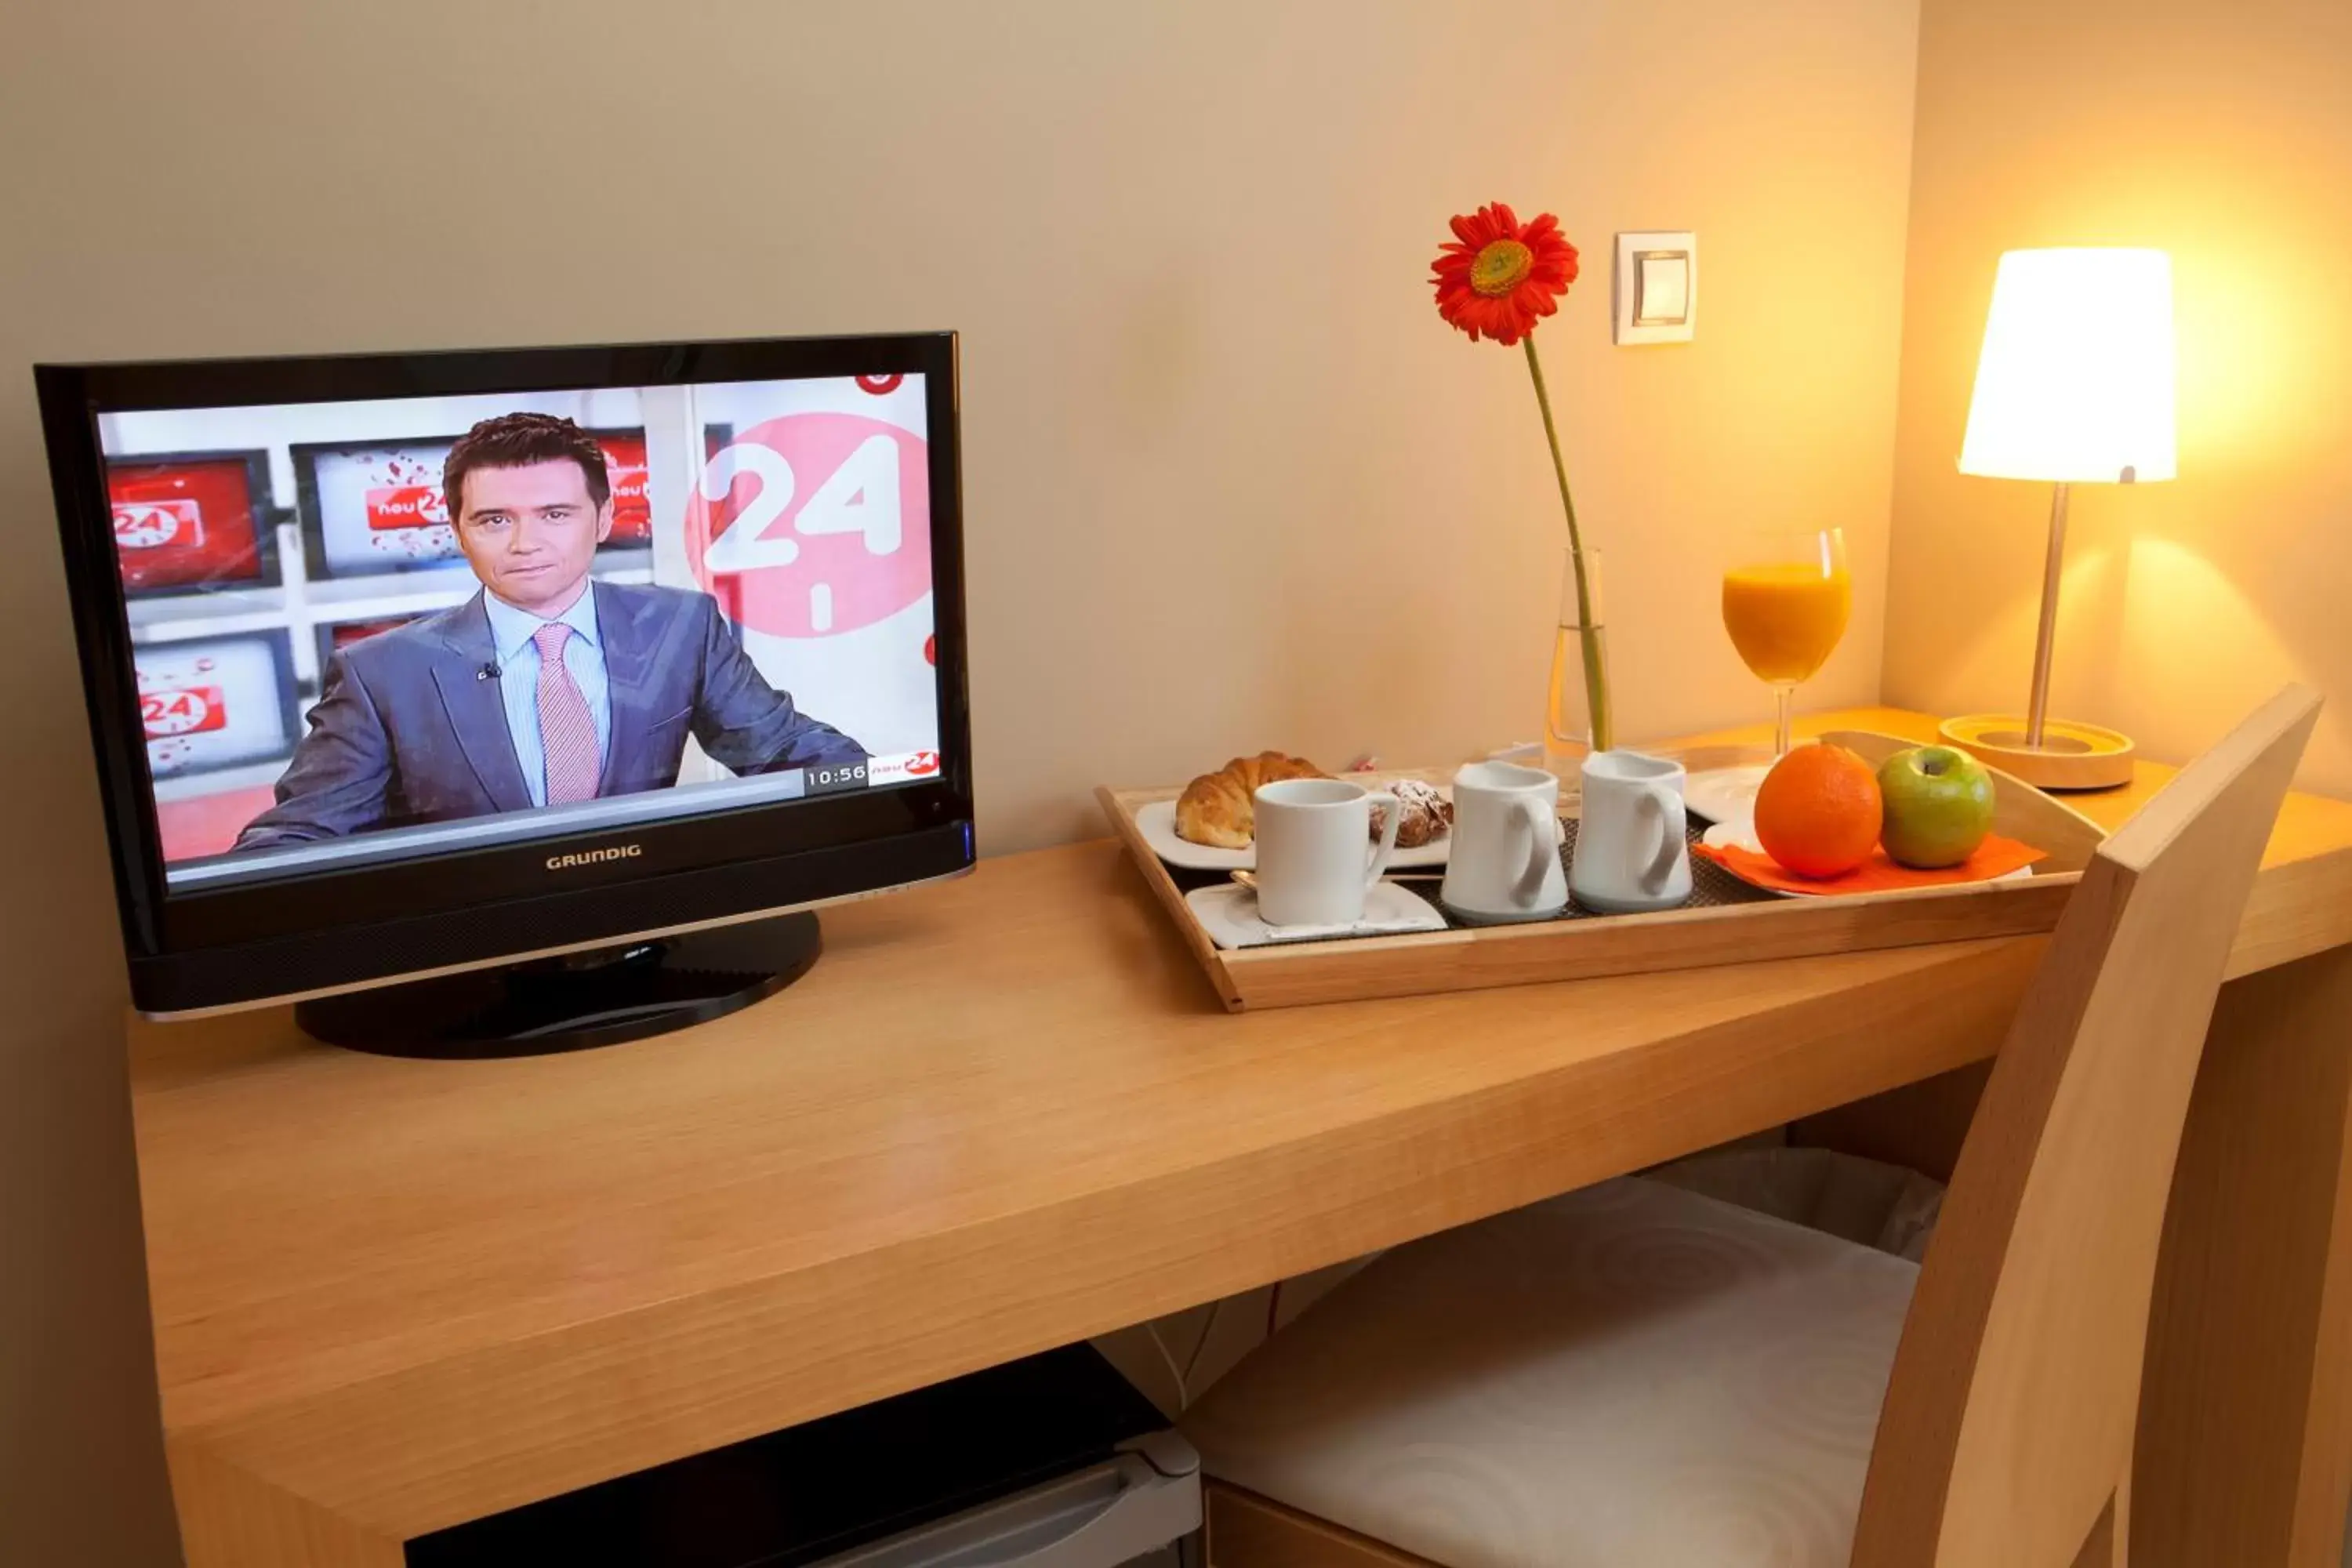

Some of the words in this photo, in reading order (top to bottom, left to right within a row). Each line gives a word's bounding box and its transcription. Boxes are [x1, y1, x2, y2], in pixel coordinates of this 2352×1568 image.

[699, 435, 901, 572] 24
[112, 510, 162, 535] 24
[141, 694, 191, 721] 24
[808, 765, 866, 786] 10:56
[906, 750, 936, 771] 24
[546, 844, 641, 869] GRUNDIG
